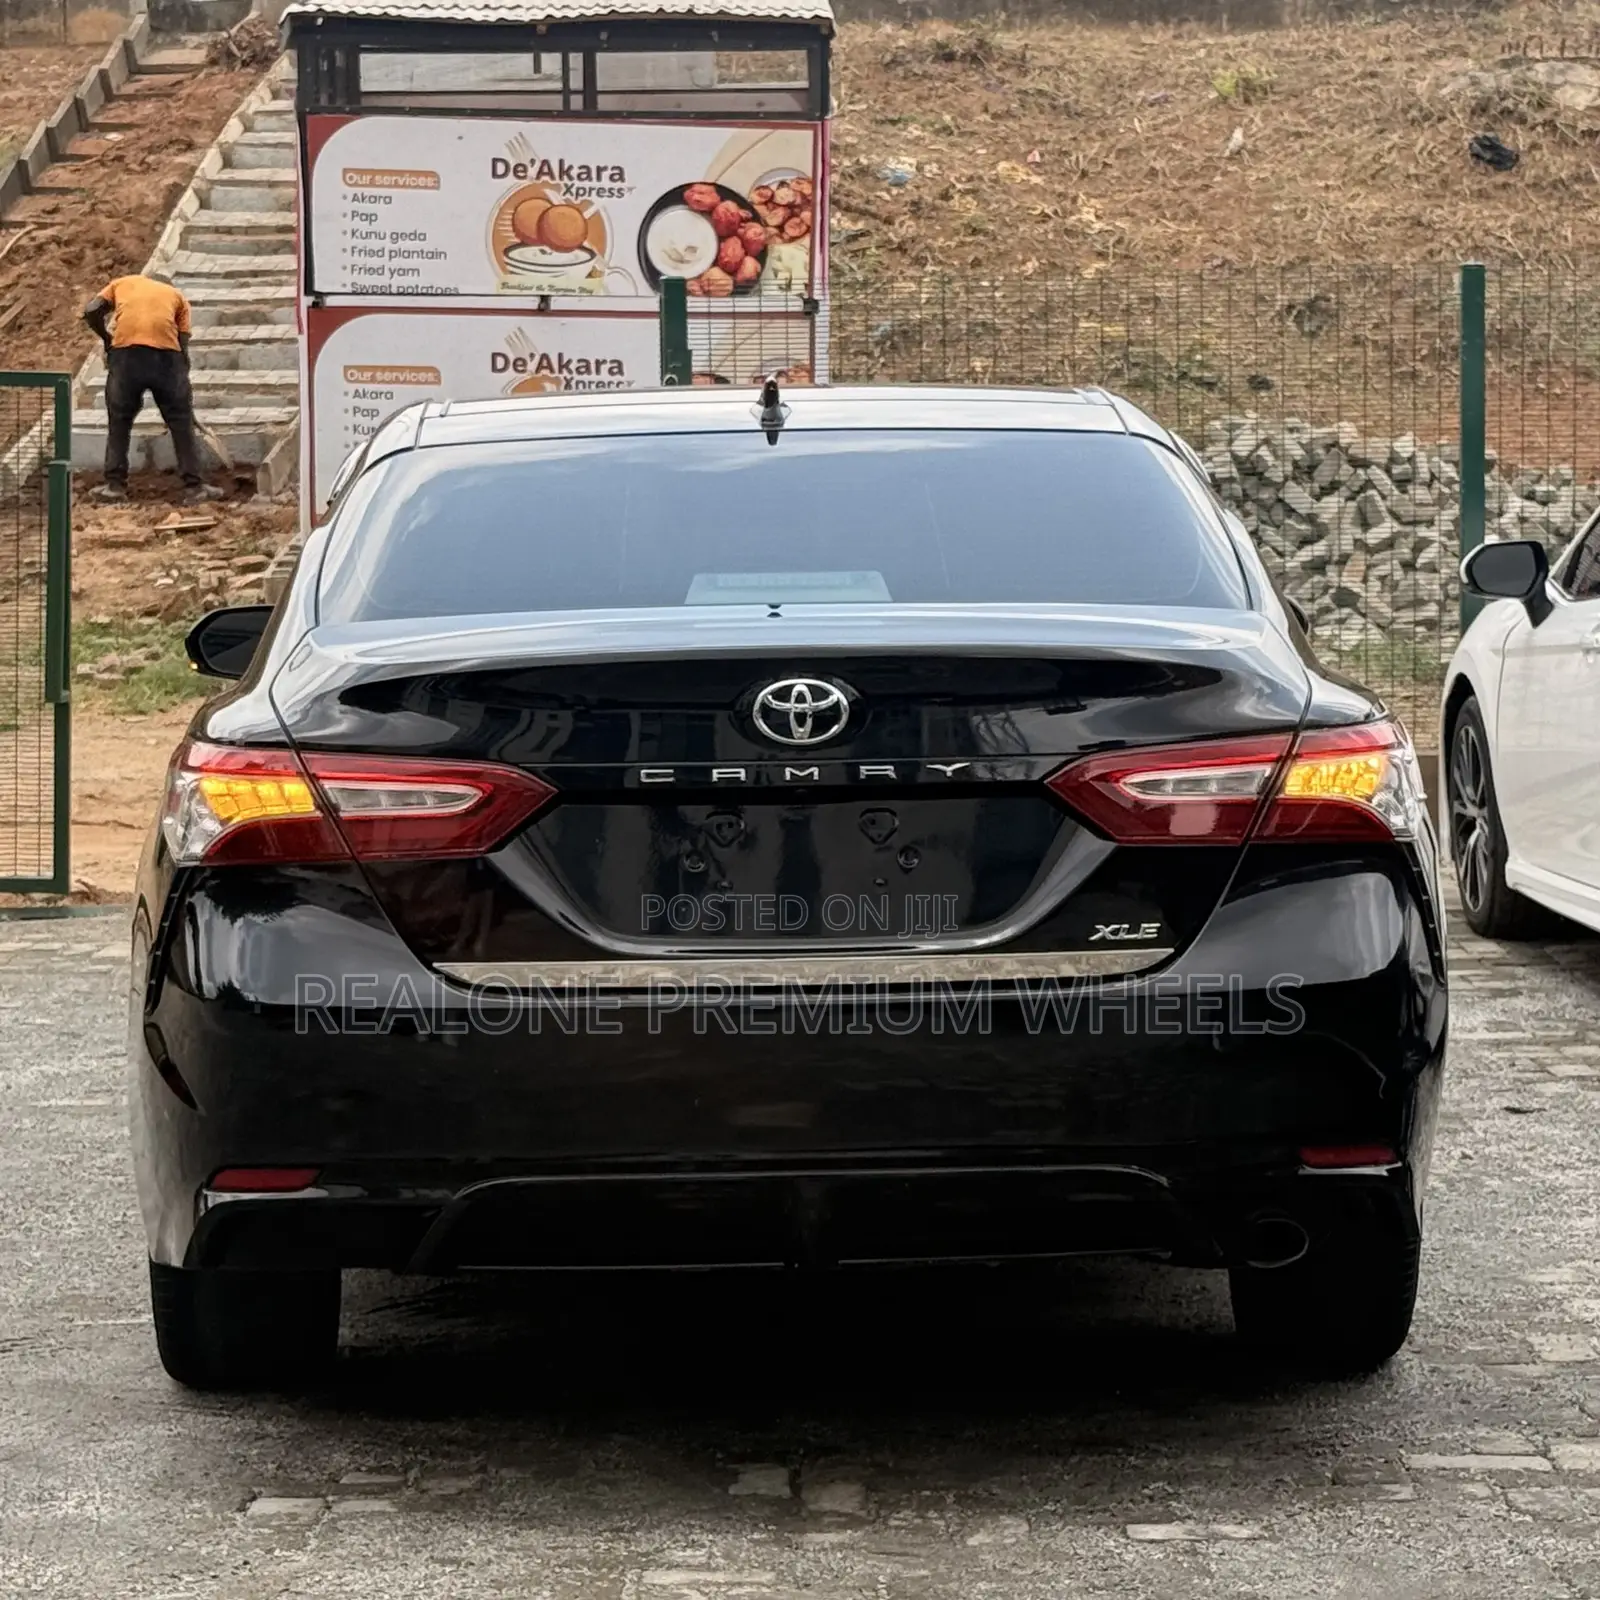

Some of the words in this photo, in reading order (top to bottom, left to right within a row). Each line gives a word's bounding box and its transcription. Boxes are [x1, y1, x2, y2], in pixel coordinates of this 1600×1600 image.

[491, 157, 626, 183] De’Akara
[345, 171, 372, 185] Our
[375, 173, 438, 187] services:
[351, 192, 392, 205] Akara
[562, 183, 626, 200] Xpress
[351, 210, 378, 226] Pap
[351, 228, 386, 240] Kunu
[390, 229, 427, 244] geda
[351, 246, 385, 258] Fried
[388, 248, 447, 262] plantain
[351, 264, 385, 276] Fried
[388, 266, 420, 280] yam
[351, 282, 392, 293] Sweet
[491, 352, 625, 377] De’Akara
[347, 369, 372, 381] Our
[352, 388, 394, 400] Akara
[352, 406, 379, 420] Pap
[640, 763, 970, 783] CAMRY
[1087, 922, 1161, 941] XLE
